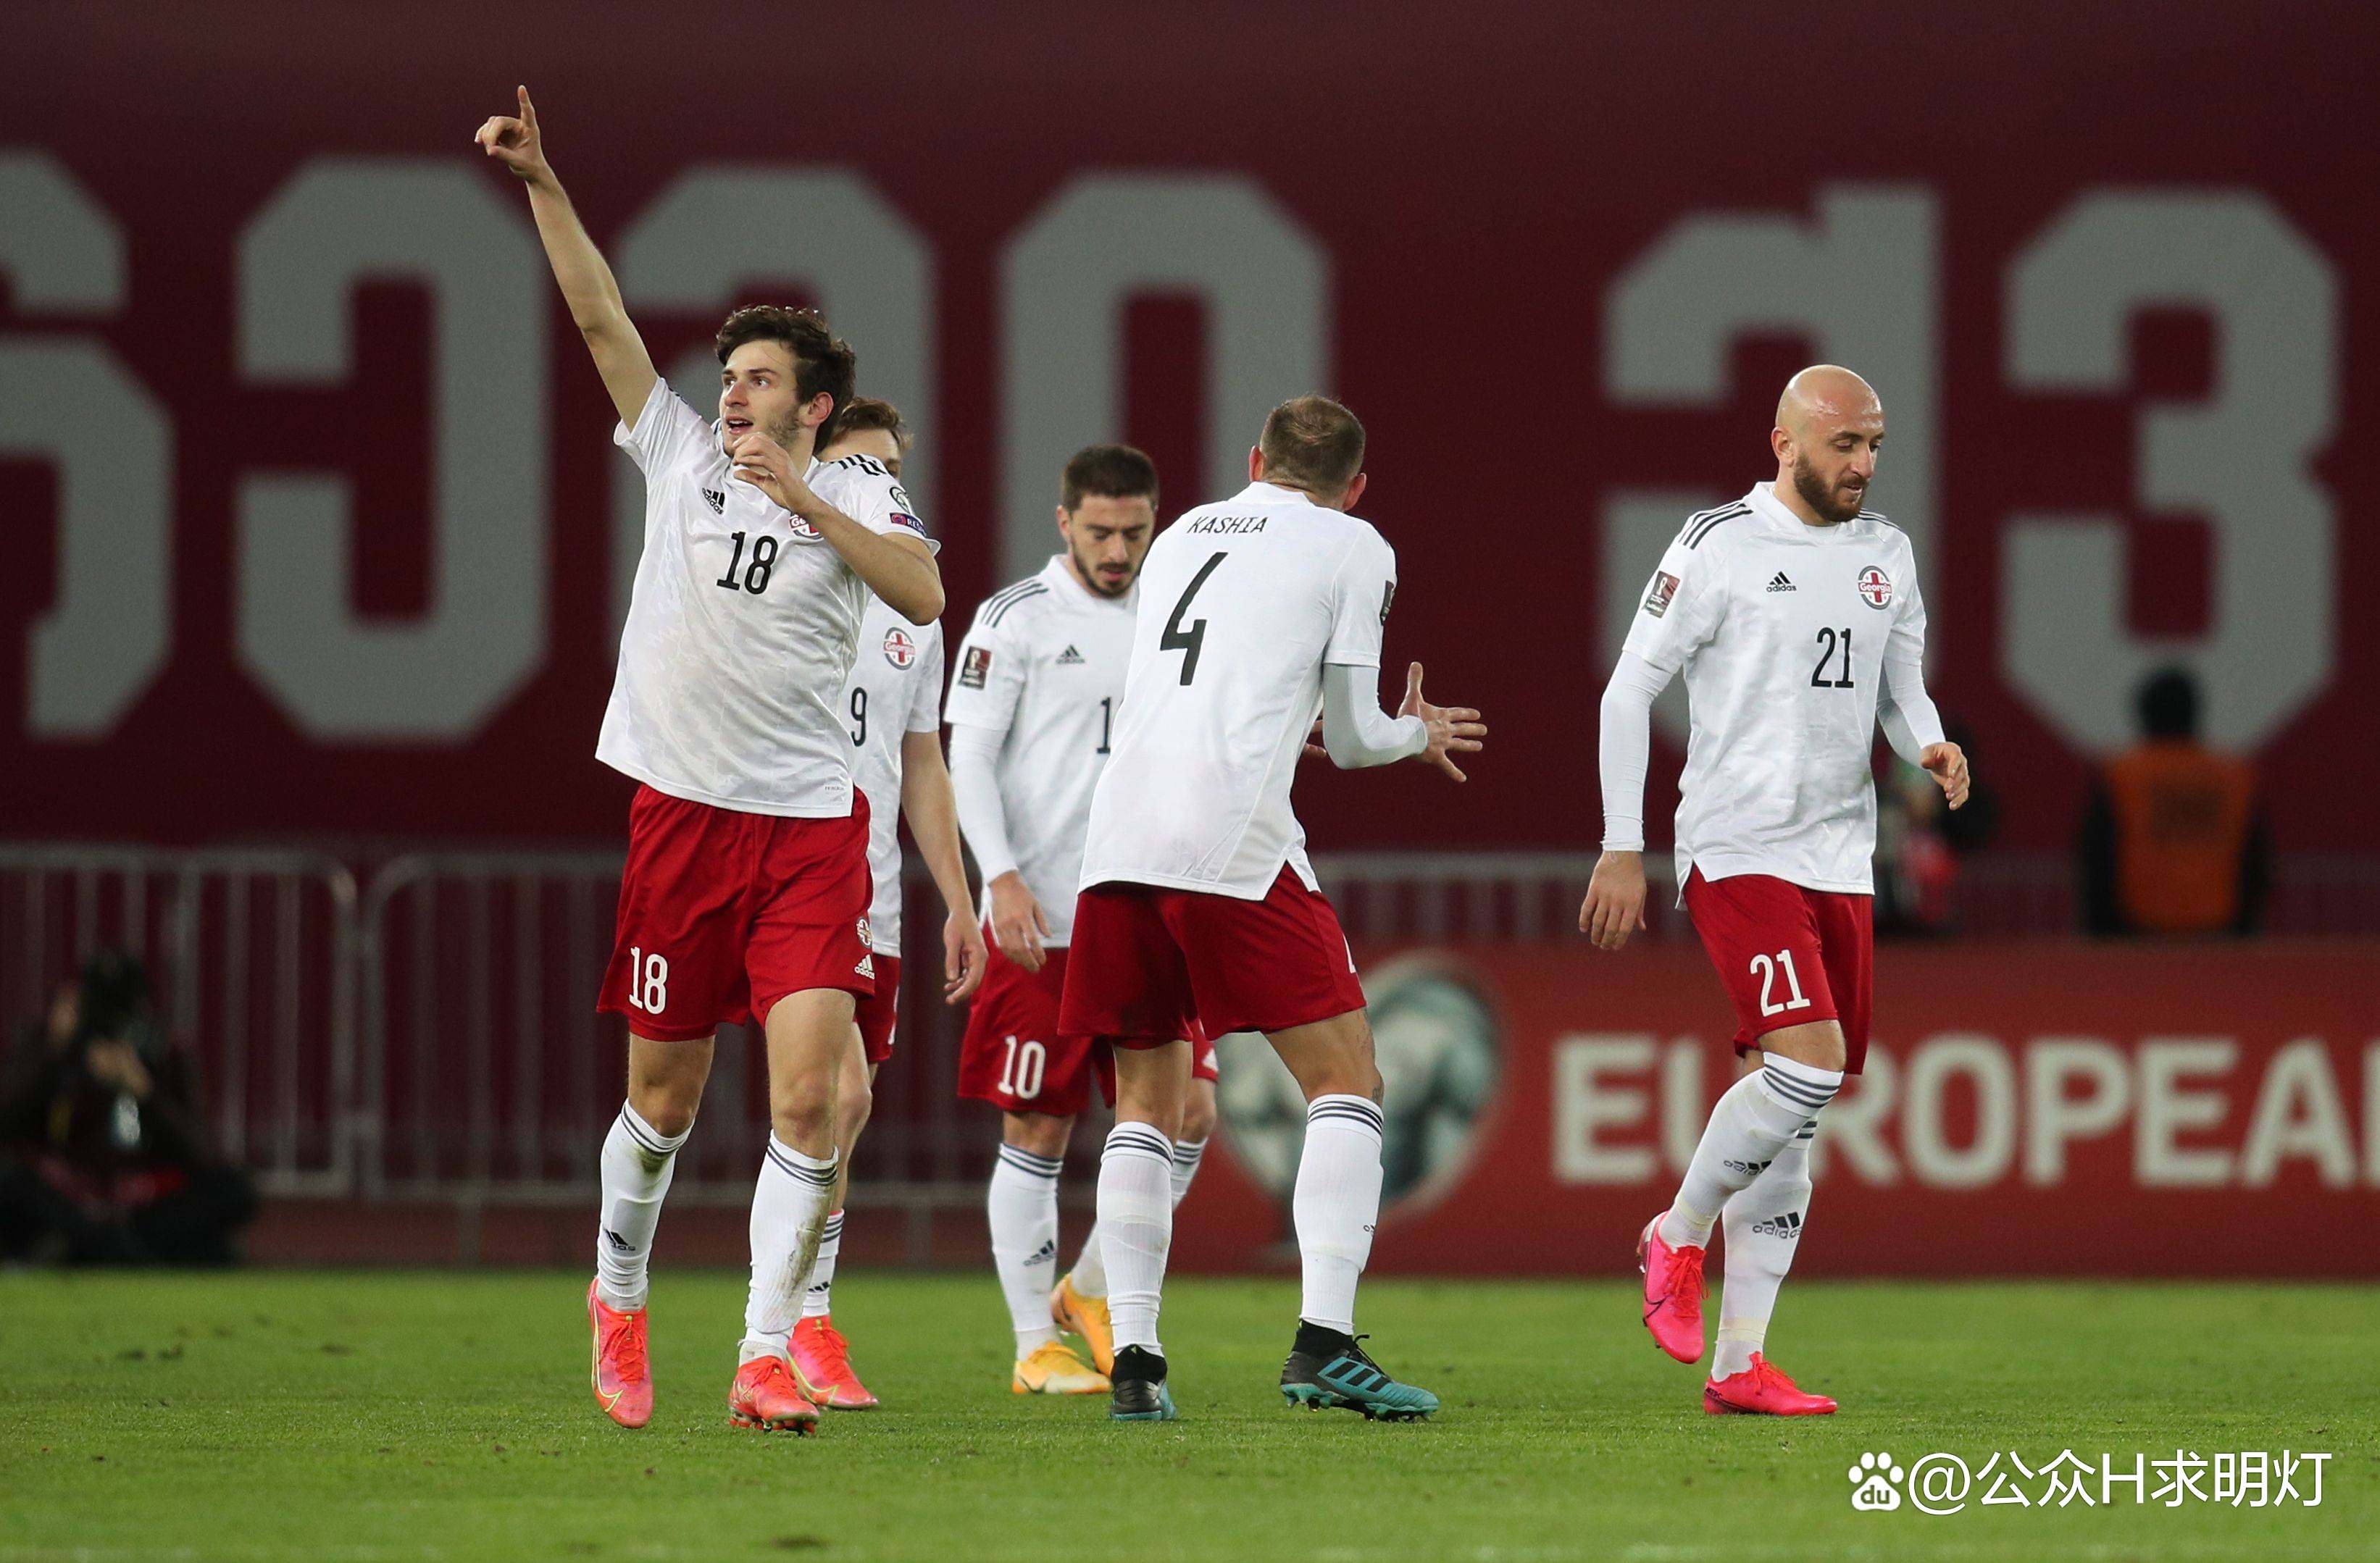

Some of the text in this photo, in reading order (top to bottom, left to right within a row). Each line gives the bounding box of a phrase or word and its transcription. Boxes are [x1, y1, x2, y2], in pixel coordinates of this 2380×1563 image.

[702, 487, 724, 514] adidas
[1187, 516, 1269, 534] KASHIA
[717, 531, 779, 595] 18
[1766, 584, 1797, 592] adidas
[1858, 582, 1892, 594] Georgia
[1160, 551, 1228, 686] 4
[1811, 627, 1854, 688] 21
[1096, 697, 1111, 754] 1
[628, 946, 668, 1015] 18
[1750, 949, 1811, 1016] 21
[998, 1035, 1045, 1099] 10
[1553, 1034, 2380, 1188] EROPEA
[1724, 1160, 1763, 1175] adid
